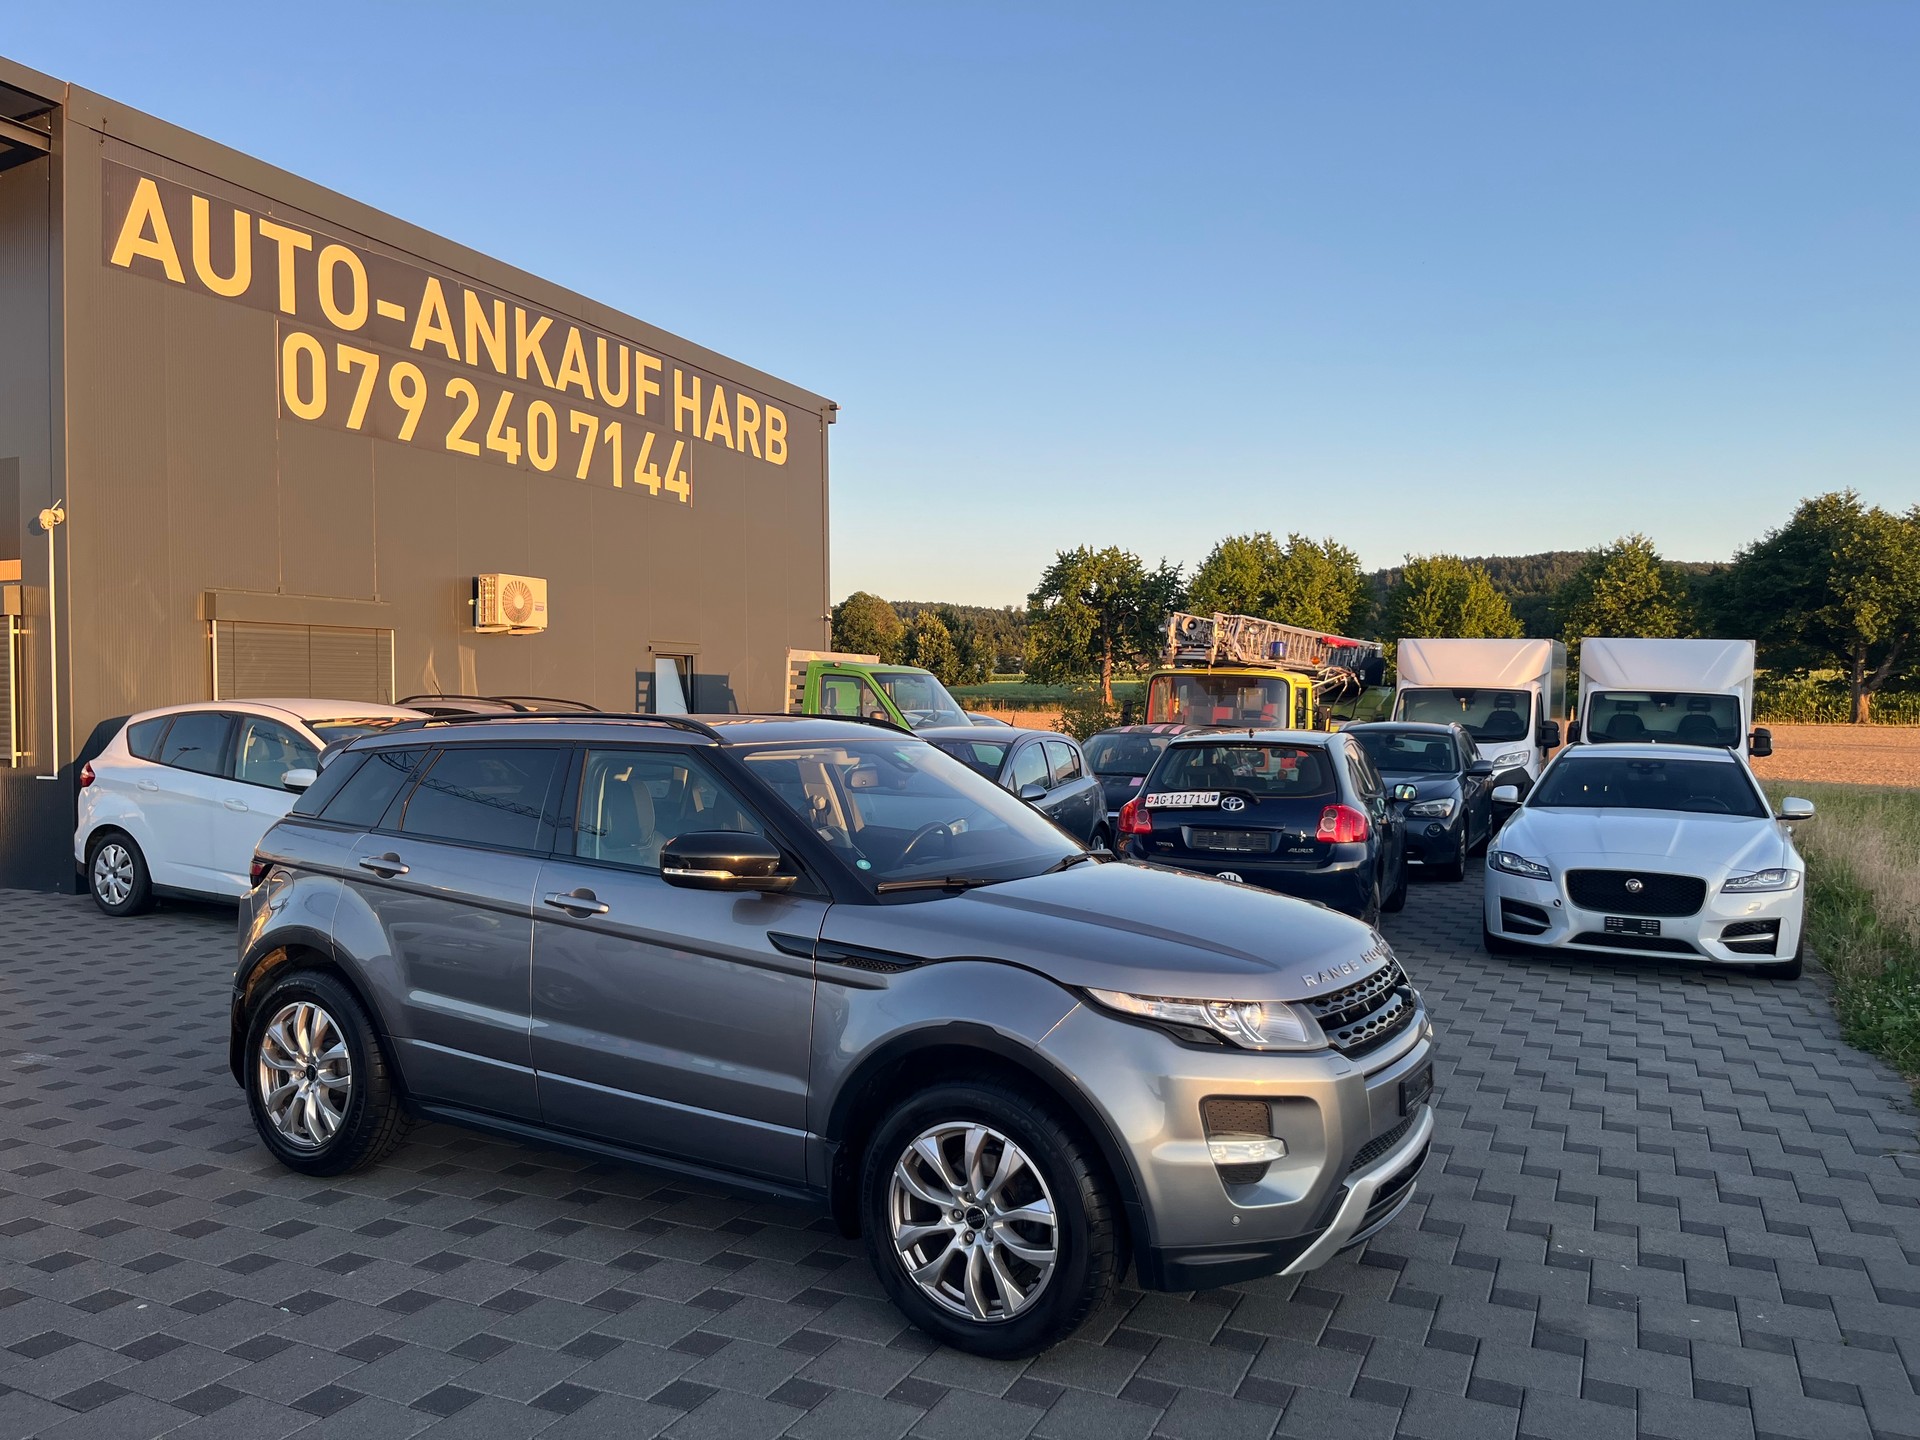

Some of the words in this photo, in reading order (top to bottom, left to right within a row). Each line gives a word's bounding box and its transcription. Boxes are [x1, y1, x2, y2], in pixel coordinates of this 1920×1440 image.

[110, 176, 662, 416] AUTO-ANKAUF
[673, 368, 789, 466] HARB
[281, 331, 428, 442] 079
[444, 377, 558, 472] 240
[1301, 959, 1361, 987] RANGE
